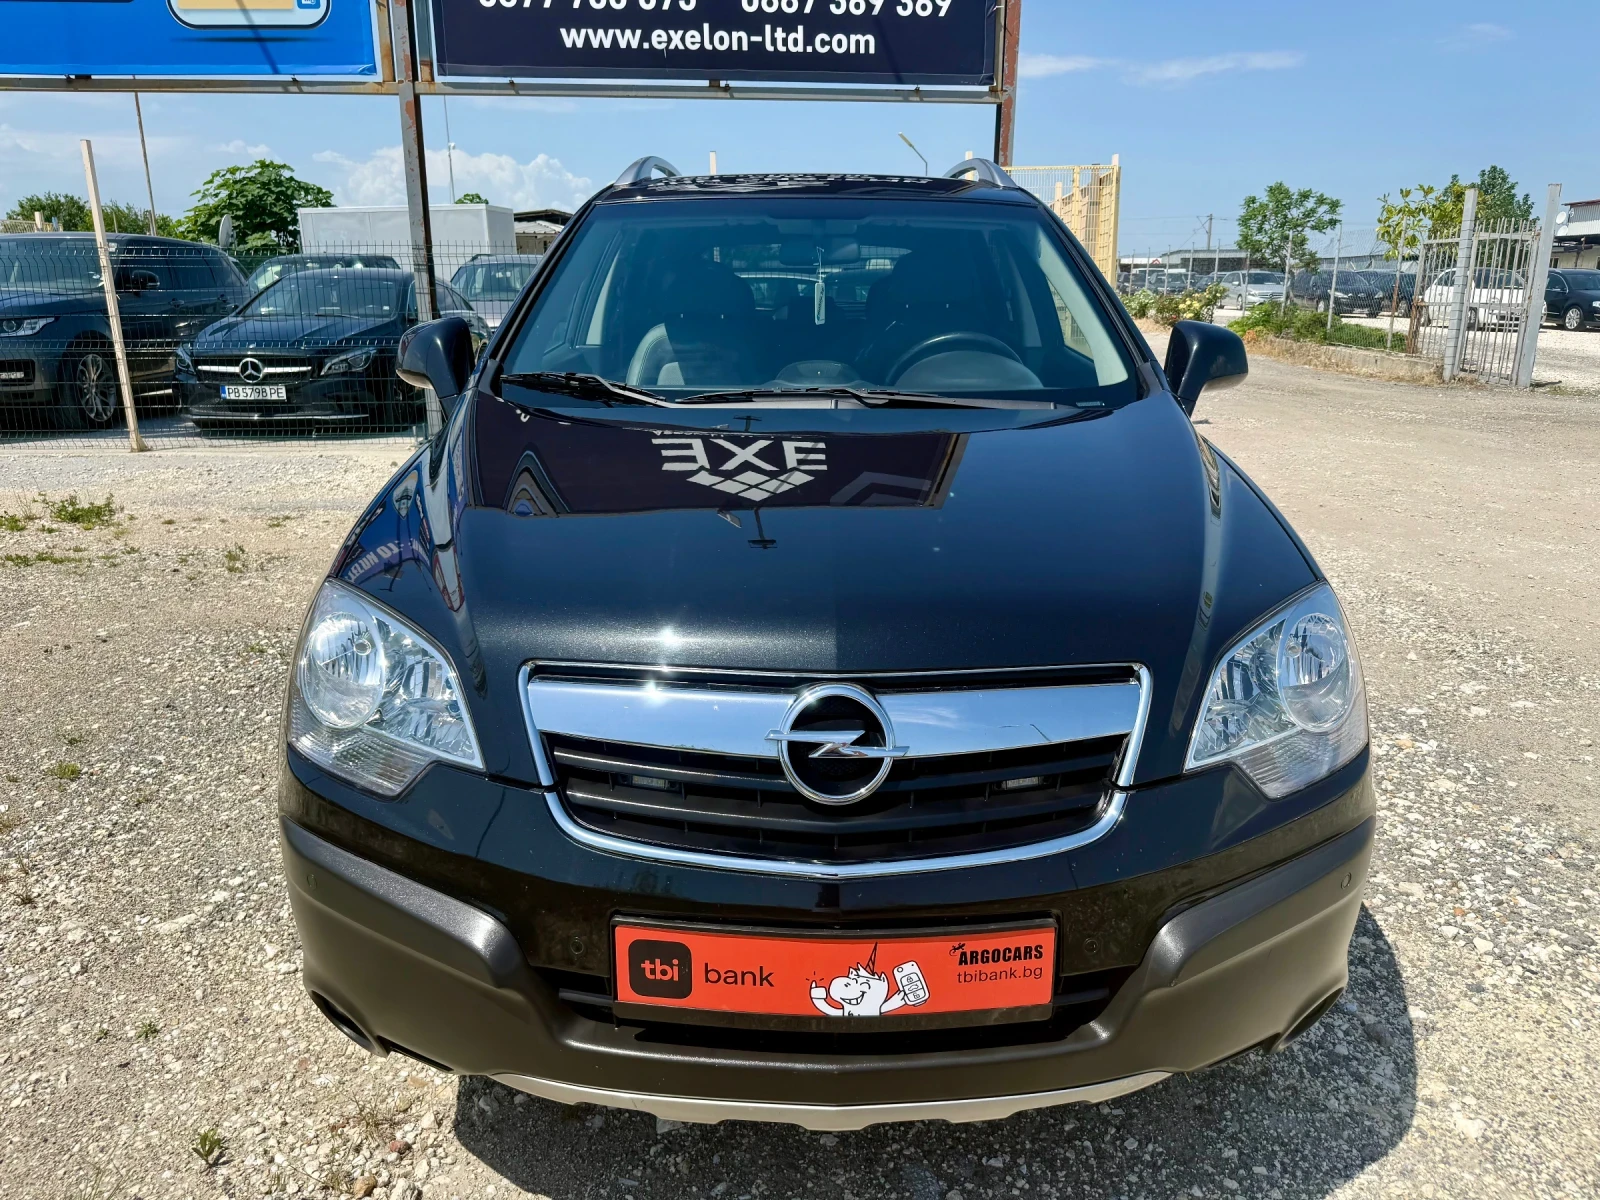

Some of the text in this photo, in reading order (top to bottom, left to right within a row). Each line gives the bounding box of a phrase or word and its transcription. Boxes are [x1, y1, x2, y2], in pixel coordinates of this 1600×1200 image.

[559, 23, 876, 55] www.exelon-ltd.com
[958, 944, 1044, 966] ARGOCARS
[640, 958, 775, 988] tbi bank
[957, 965, 1043, 984] tbibank.bg
